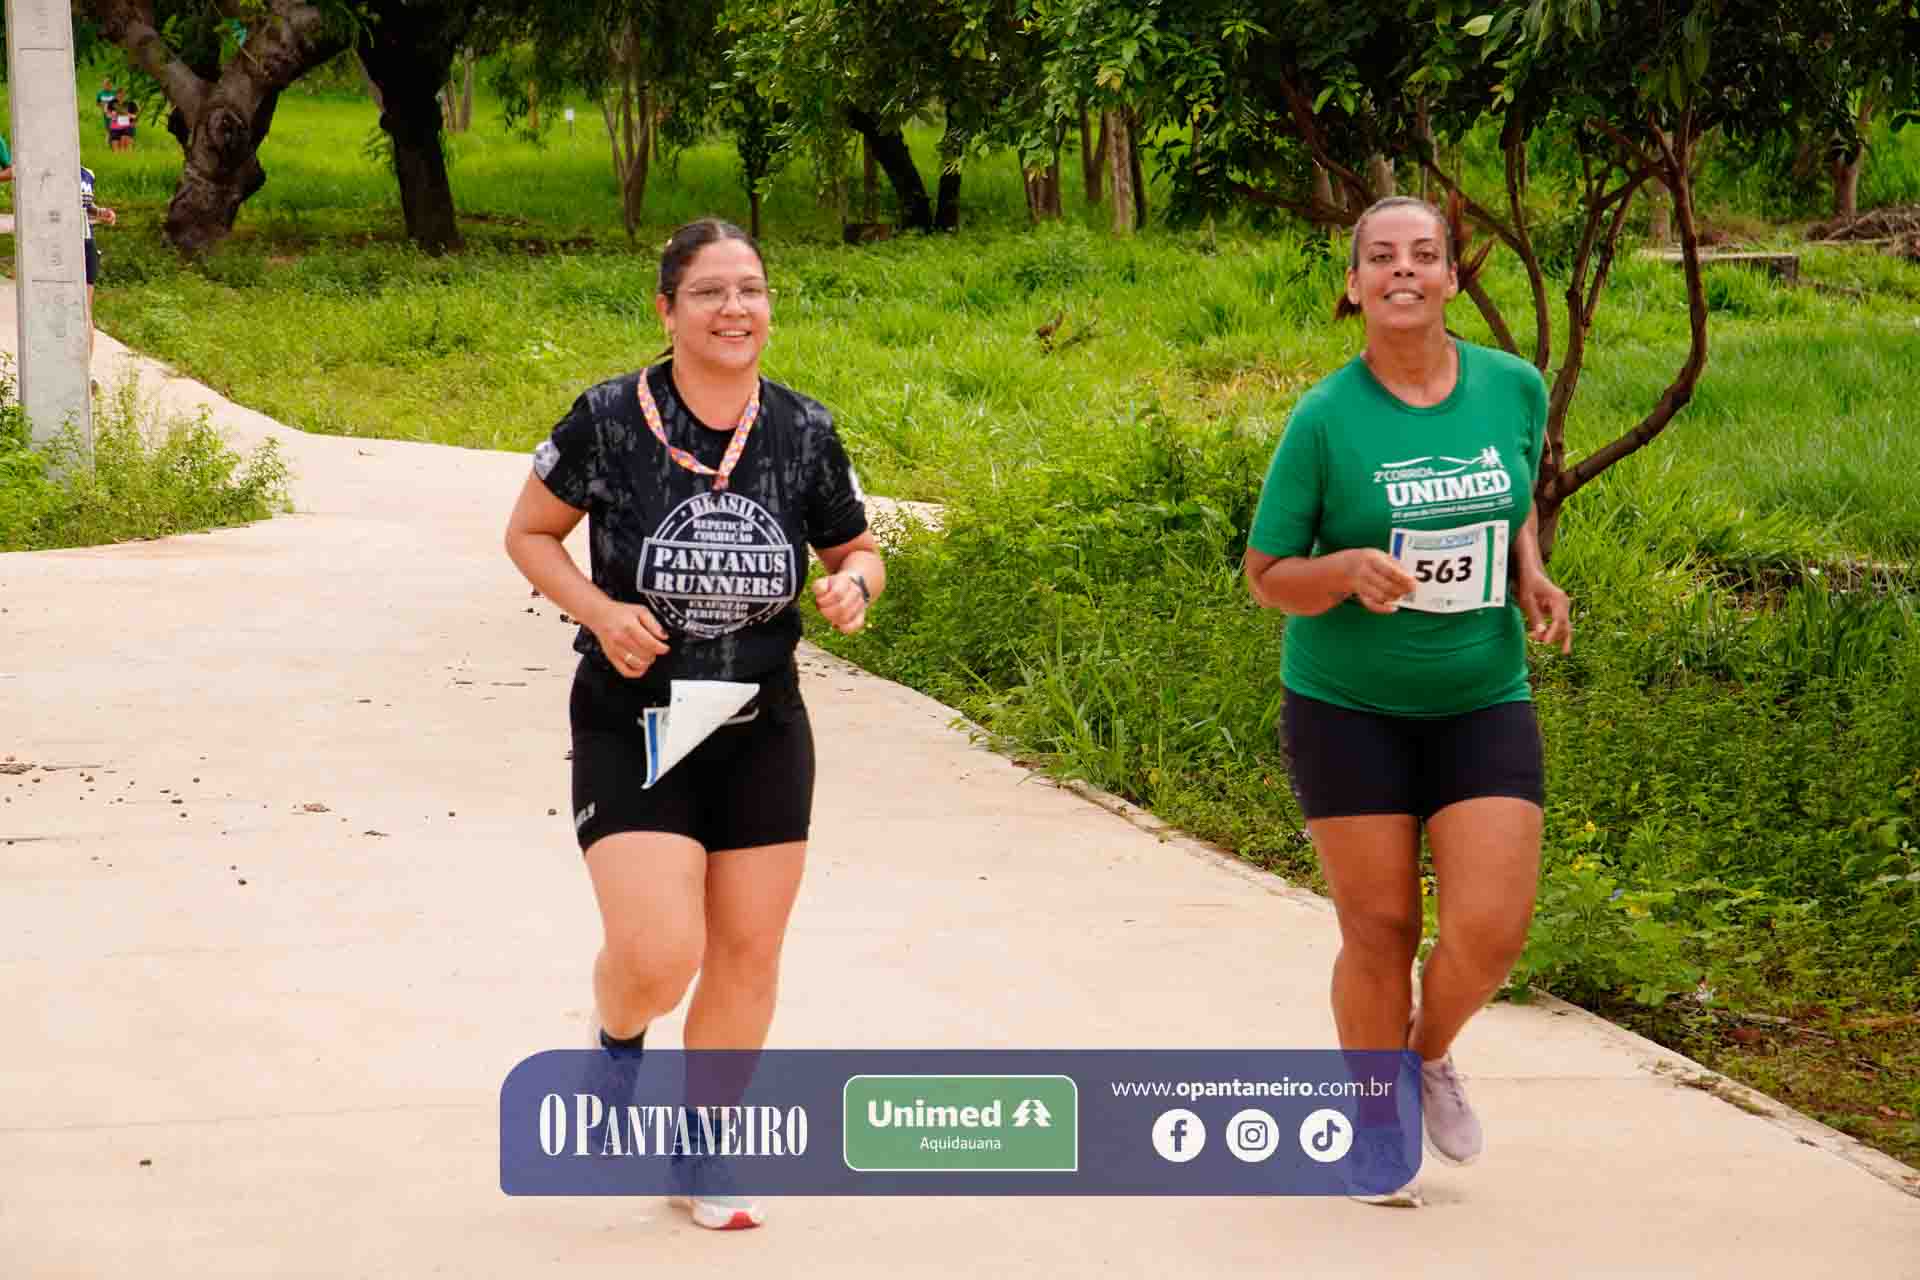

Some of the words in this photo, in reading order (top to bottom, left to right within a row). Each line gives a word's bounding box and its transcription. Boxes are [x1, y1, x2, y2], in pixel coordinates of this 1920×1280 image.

[1386, 469, 1511, 507] UNIMED
[688, 495, 757, 520] BRASIL
[653, 547, 786, 573] PANTANUS
[1415, 556, 1473, 583] 563
[653, 571, 785, 596] RUNNERS
